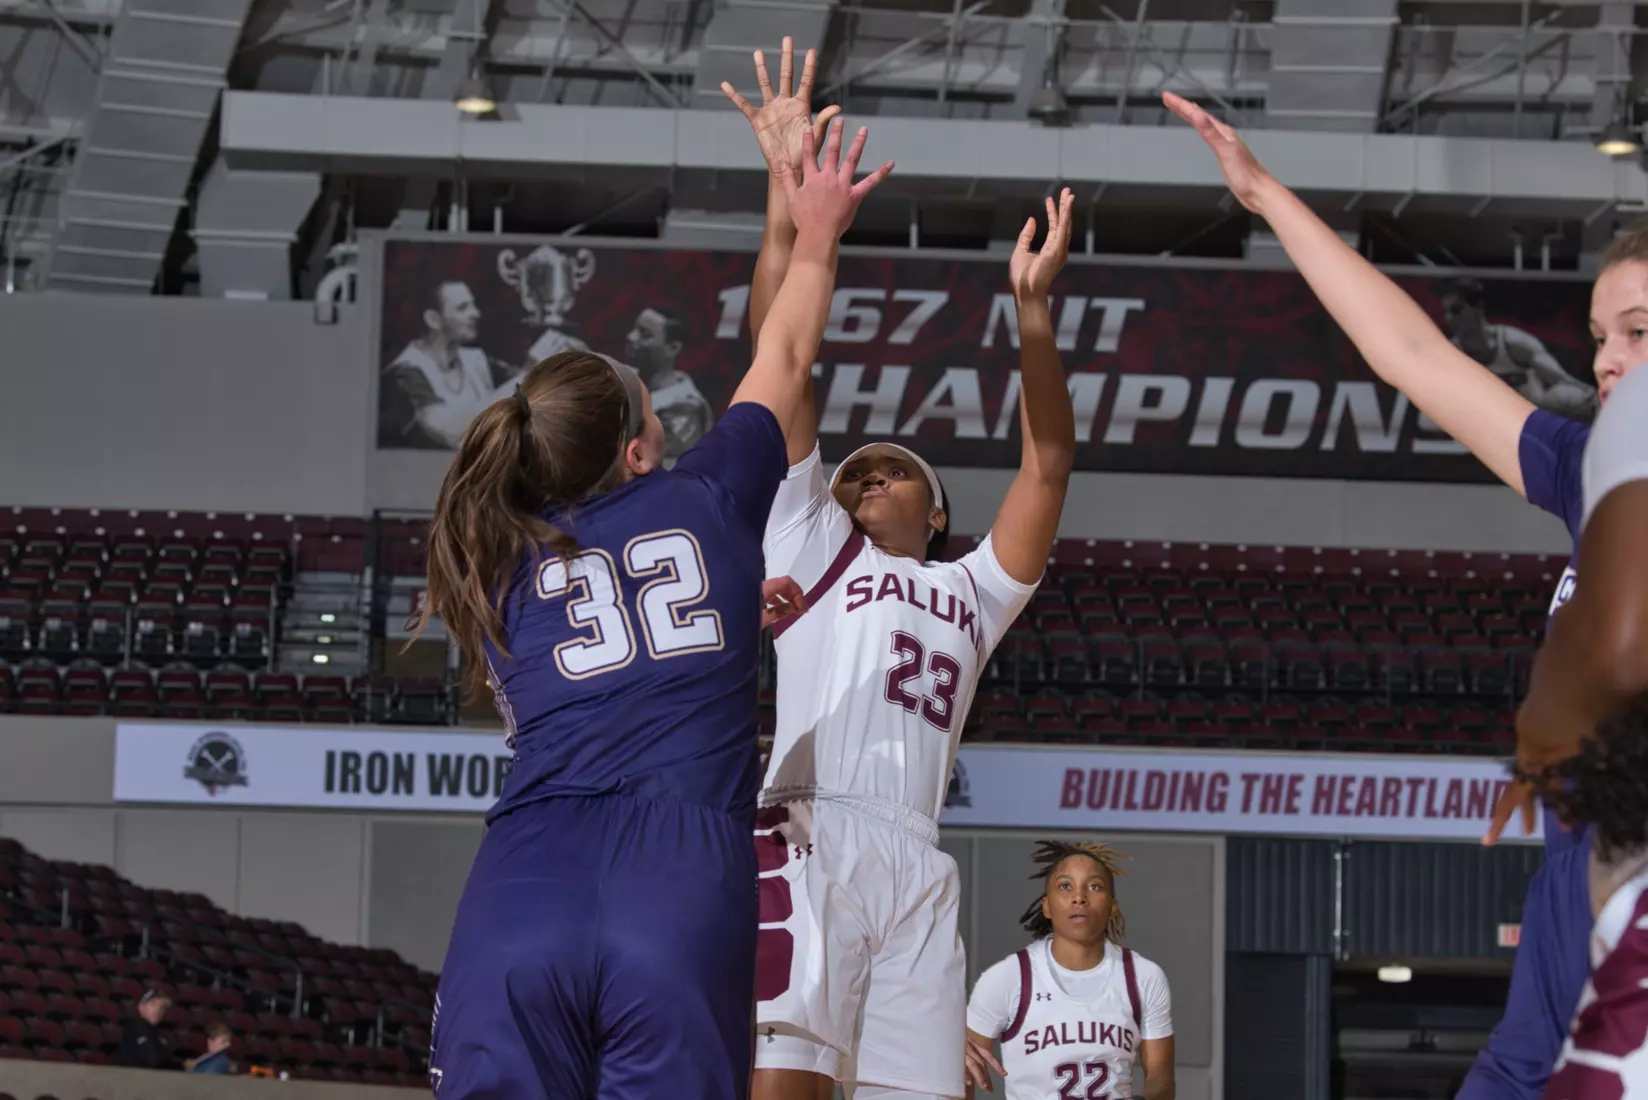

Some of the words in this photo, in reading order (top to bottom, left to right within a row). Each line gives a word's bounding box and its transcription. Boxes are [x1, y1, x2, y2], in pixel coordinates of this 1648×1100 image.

[715, 285, 949, 345] 167
[811, 362, 1474, 455] HAMPION
[536, 528, 725, 681] 32
[846, 572, 981, 651] SALUK
[884, 630, 962, 733] 23
[324, 750, 415, 795] IRON
[1059, 767, 1230, 814] BUILDING
[1240, 772, 1305, 815] THE
[1024, 1021, 1134, 1056] SALUKIS
[1054, 1059, 1113, 1100] 22
